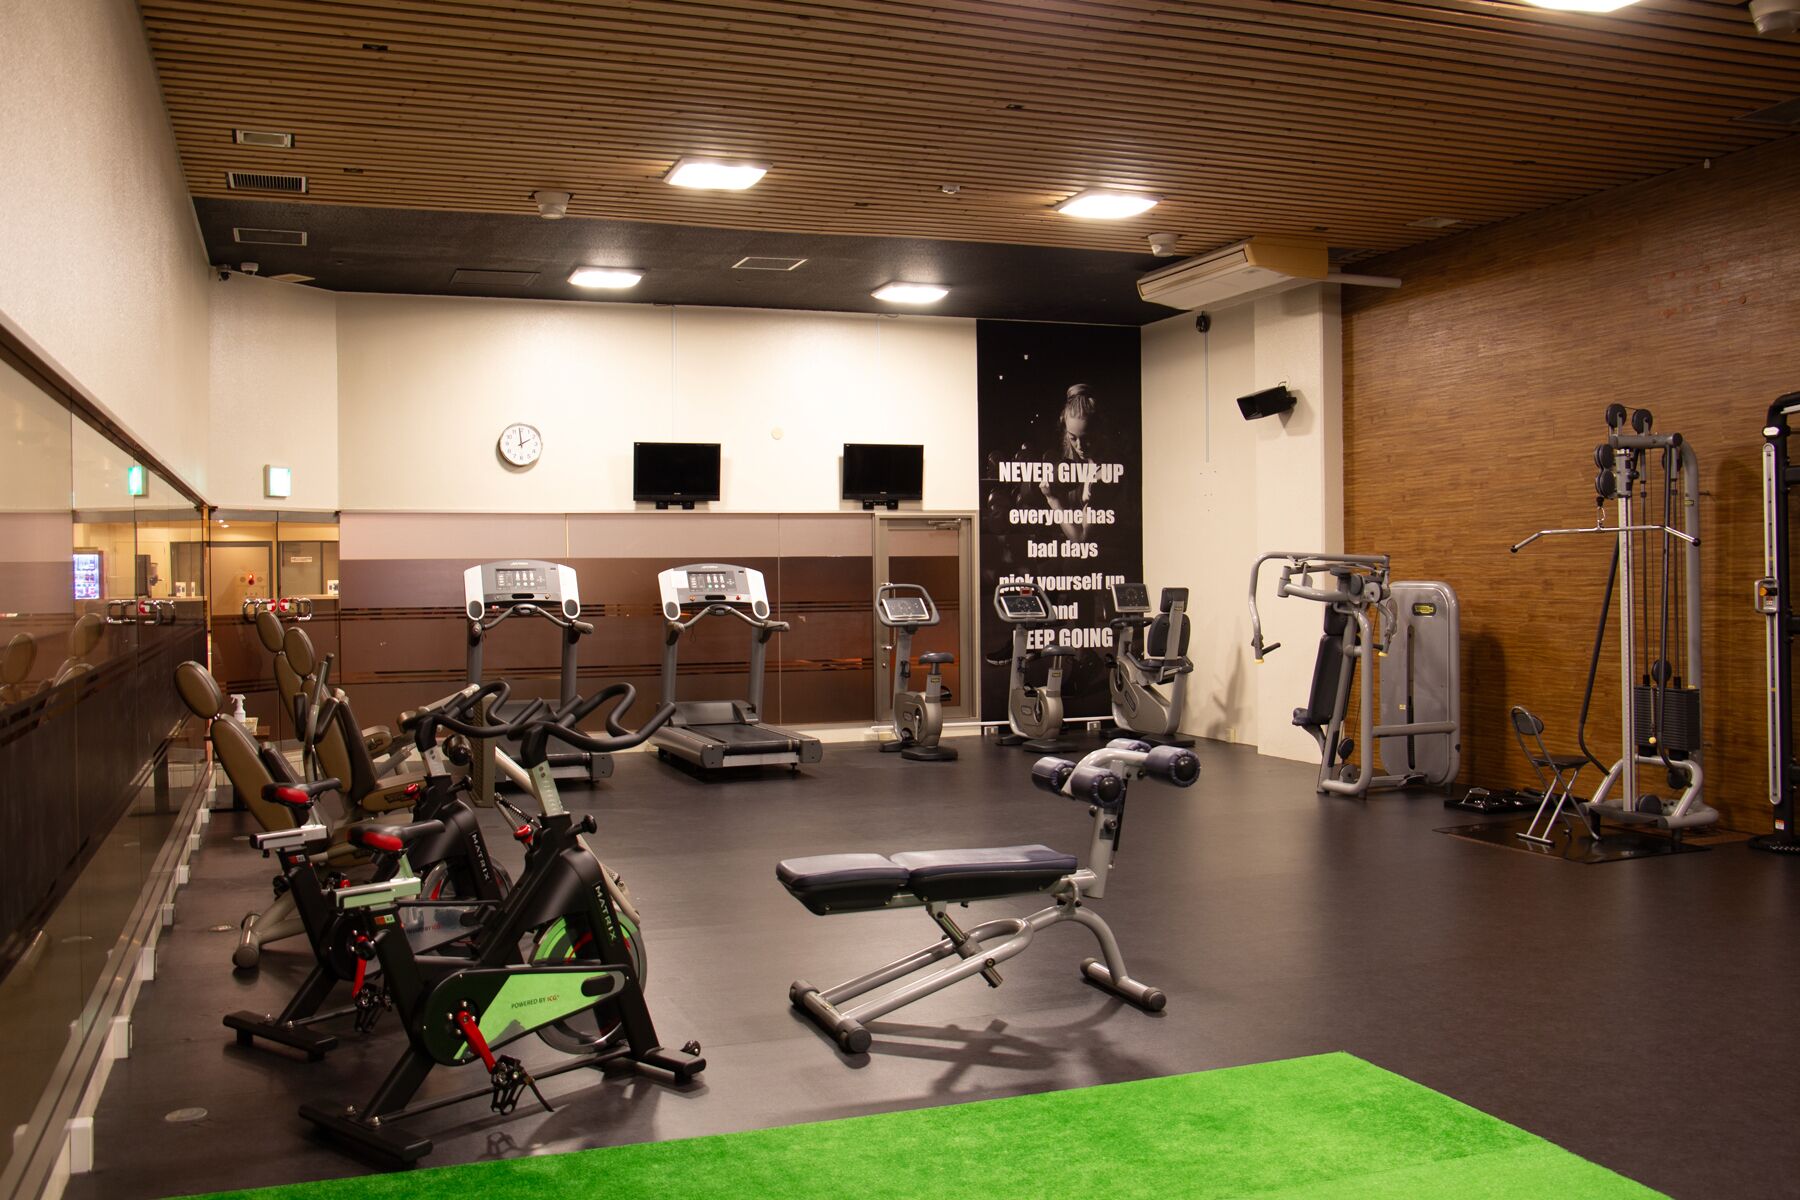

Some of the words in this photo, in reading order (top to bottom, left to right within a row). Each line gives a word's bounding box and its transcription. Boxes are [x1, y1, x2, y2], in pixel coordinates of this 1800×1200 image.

[999, 461, 1053, 482] NEVER
[1058, 462, 1098, 483] GIVE
[1101, 463, 1124, 483] UP
[1009, 507, 1083, 526] everyone
[1086, 507, 1115, 524] has
[1027, 540, 1058, 558] bad
[1060, 540, 1098, 559] days
[1037, 572, 1103, 591] yourself
[1013, 628, 1055, 650] EEP
[1059, 627, 1113, 648] GOING
[471, 833, 490, 880] MATRIX
[594, 885, 616, 940] MATRIX
[511, 998, 538, 1009] POWERED
